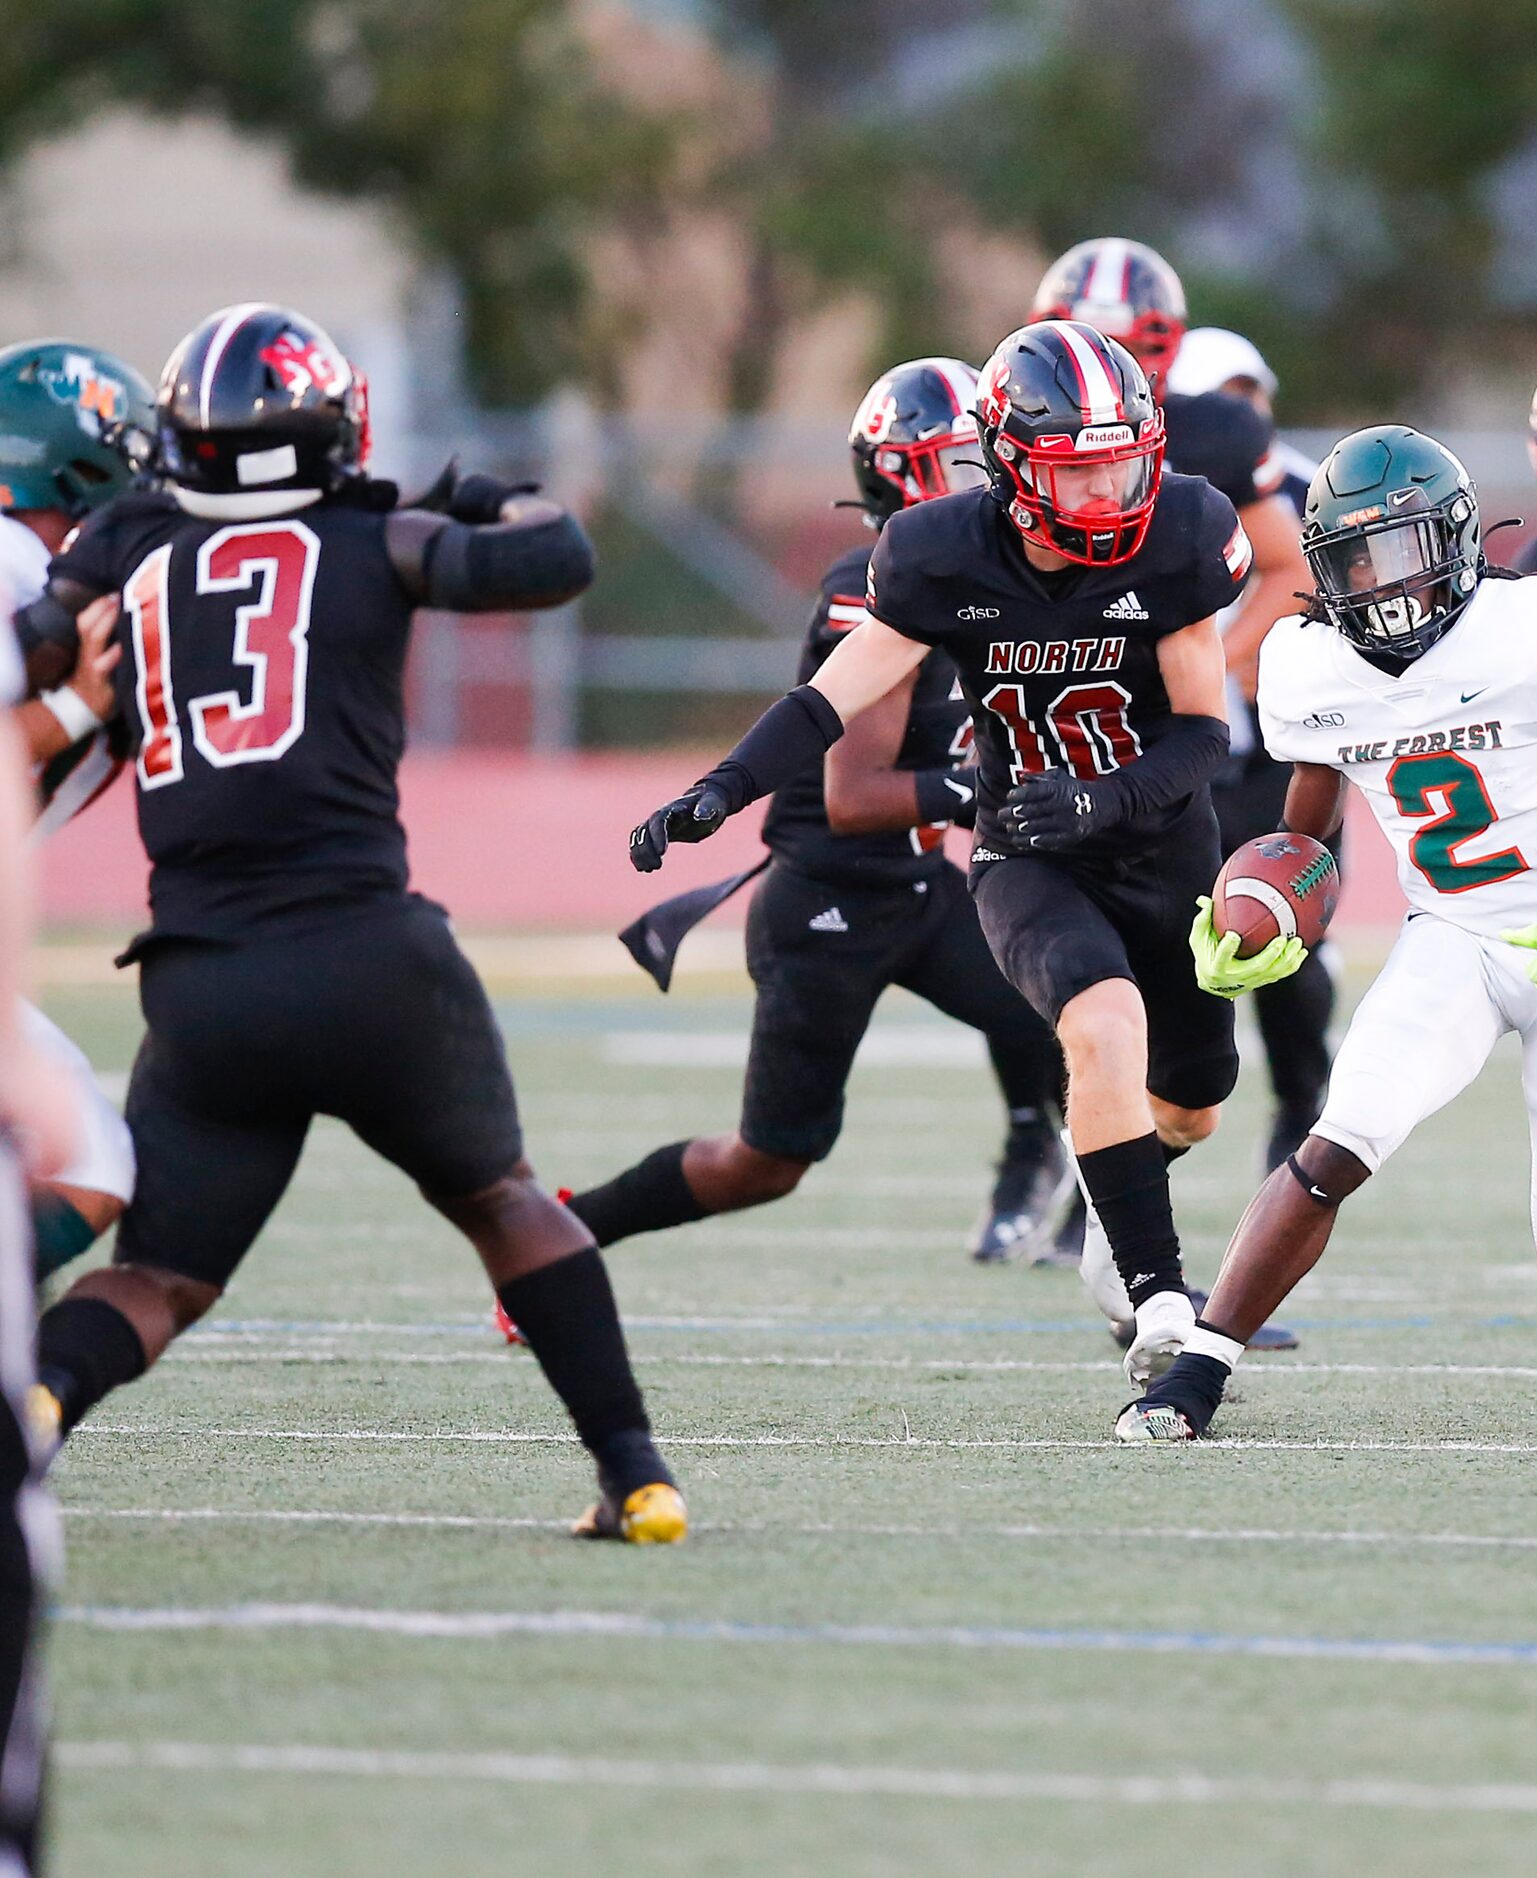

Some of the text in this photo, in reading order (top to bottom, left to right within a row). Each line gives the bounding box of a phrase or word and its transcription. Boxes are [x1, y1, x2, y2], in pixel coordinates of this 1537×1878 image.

[1085, 429, 1129, 443] Riddell
[1102, 608, 1150, 621] adidas
[123, 519, 321, 792] 13
[984, 636, 1127, 675] NORTH
[981, 680, 1144, 787] 10
[1337, 720, 1504, 764] THE FOREST
[1385, 750, 1531, 894] 2
